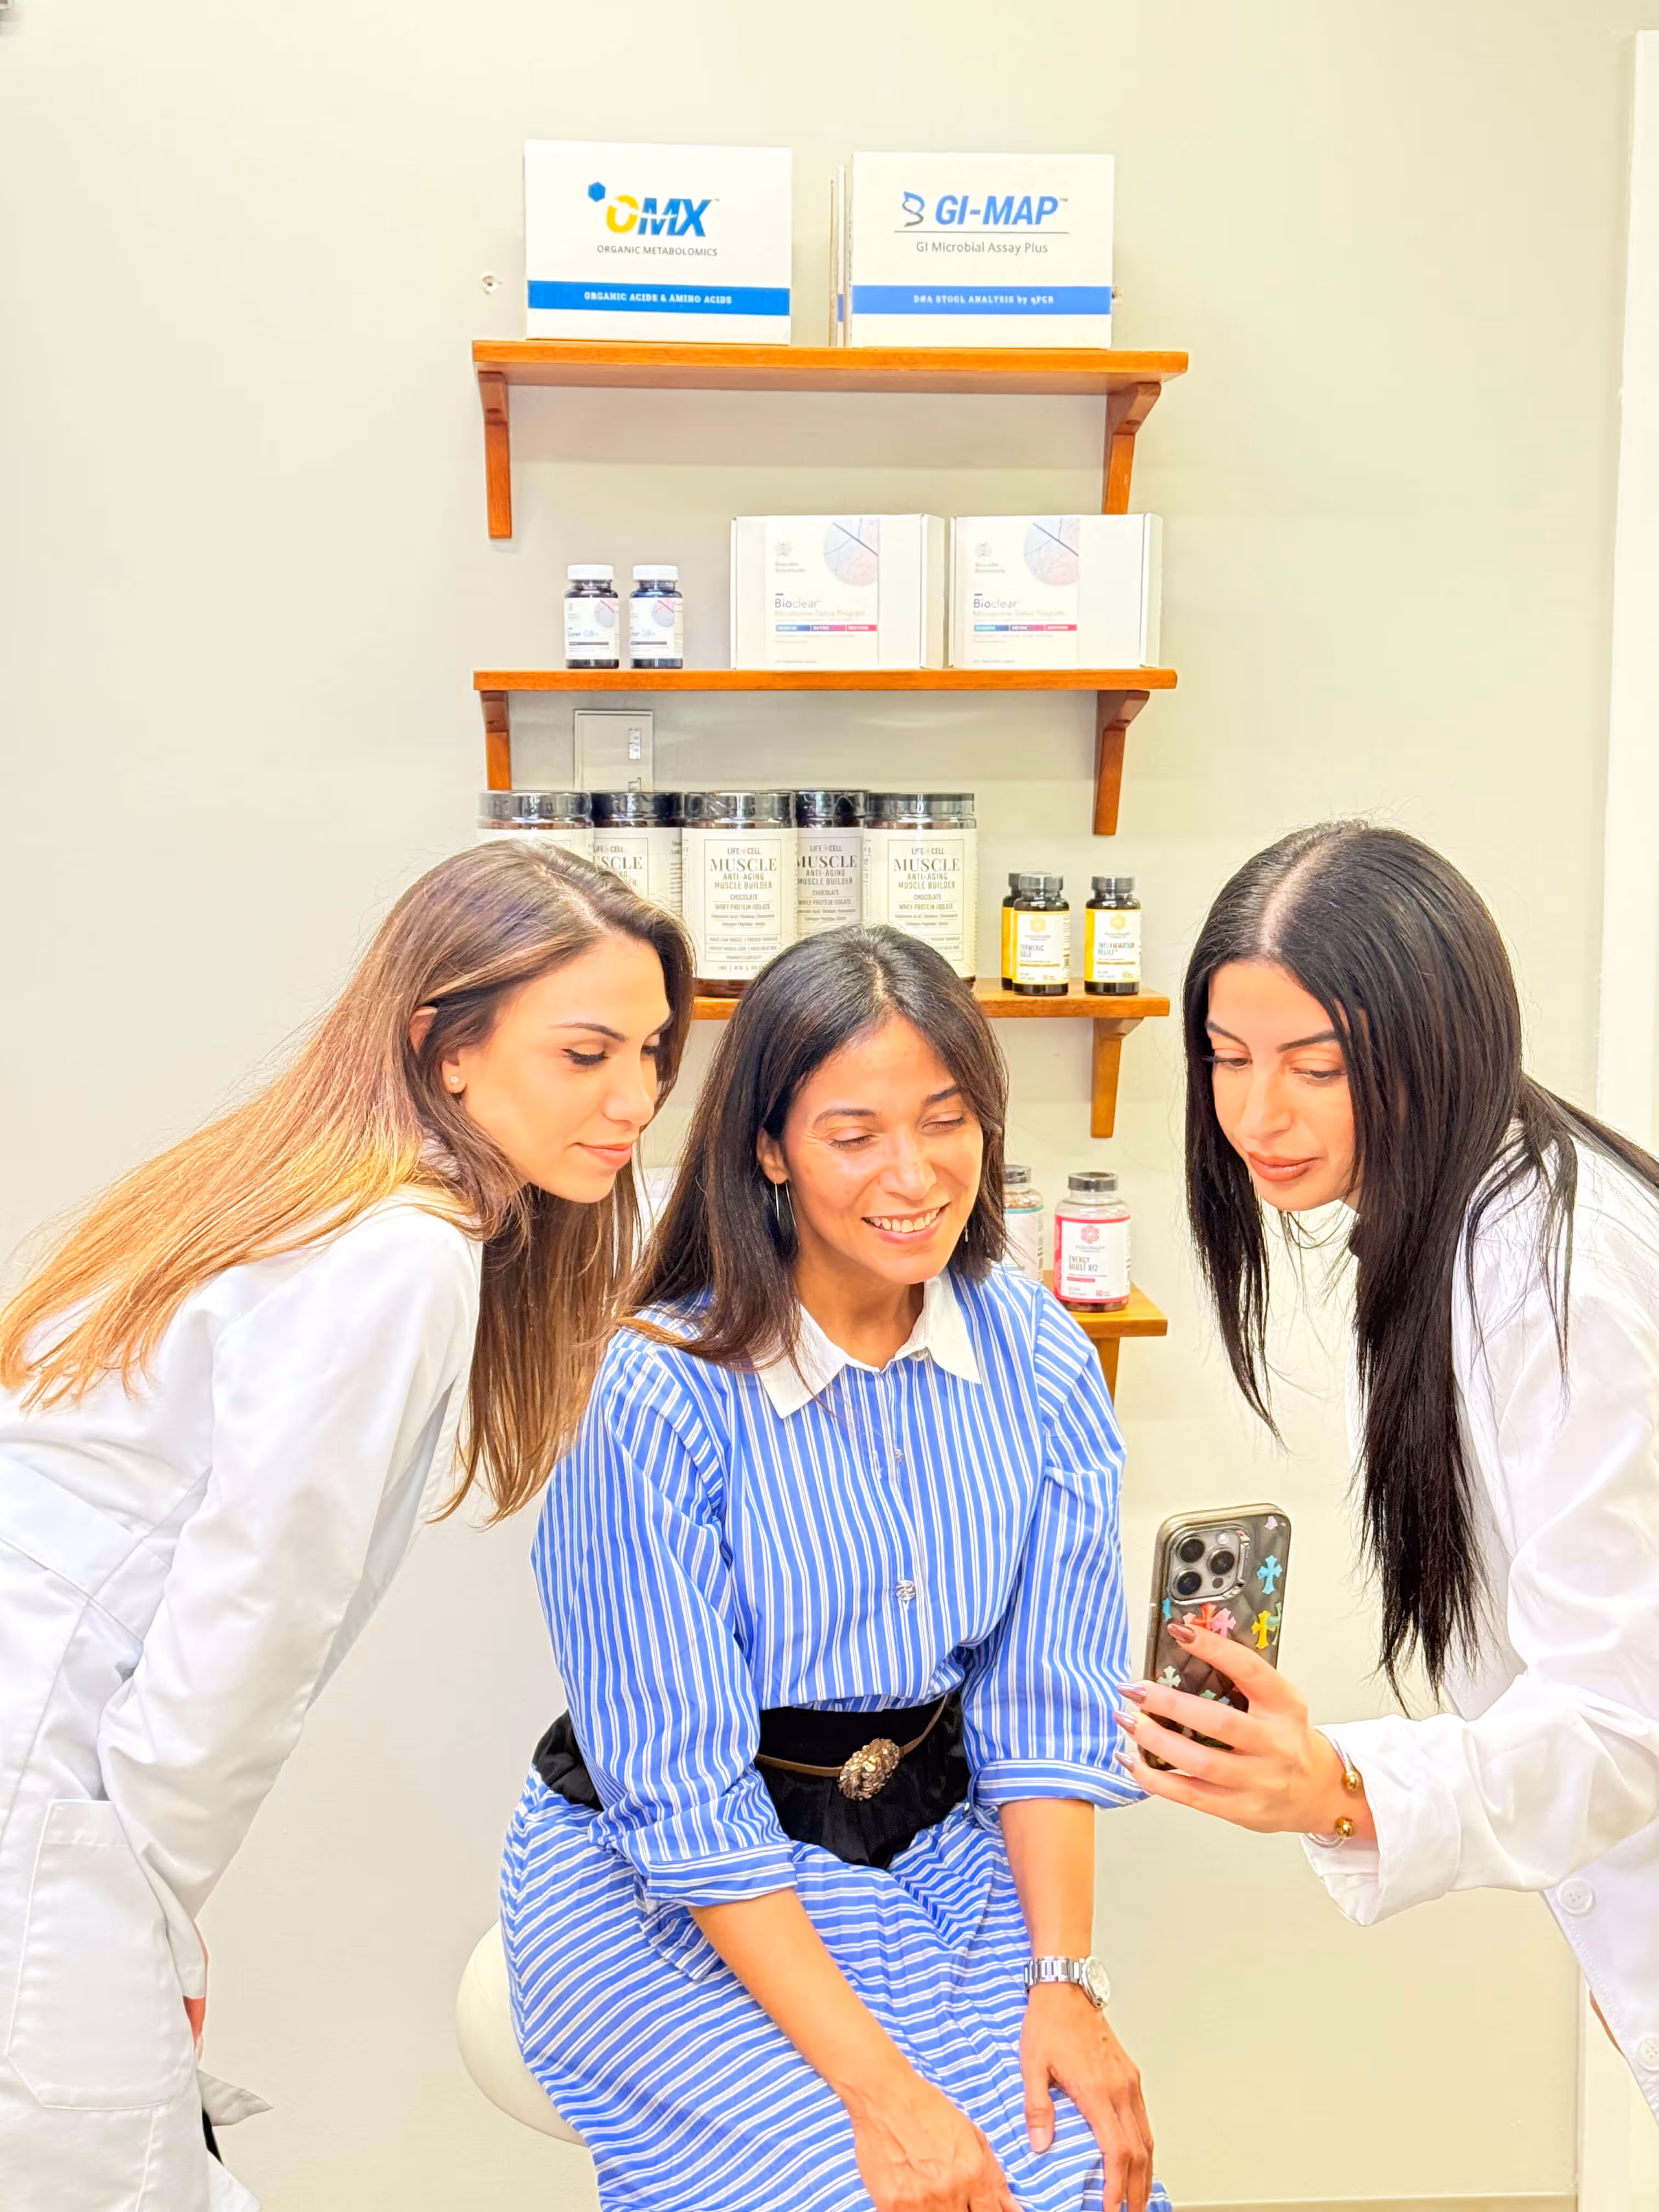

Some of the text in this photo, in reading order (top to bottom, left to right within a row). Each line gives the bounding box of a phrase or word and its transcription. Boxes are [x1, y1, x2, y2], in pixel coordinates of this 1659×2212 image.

[935, 194, 1058, 225] GI-MAP
[606, 195, 712, 237] OMX
[596, 245, 718, 256] ORGANIC METABOLOMICS
[916, 241, 1048, 255] GI Microbial Assay Plus
[584, 291, 732, 304] ORGANIC ACIDS & AMINO ACIDS
[913, 294, 1054, 305] DNA STOOL ANALYSIS by qPCR
[775, 597, 817, 608] Bioclear
[973, 597, 1017, 608] Bioclear
[710, 858, 777, 872] MUSCLE
[797, 855, 857, 868] MUSCLE
[894, 858, 960, 872] MUSCLE
[907, 872, 948, 881] ANTI-AGING
[744, 881, 772, 889] BUILDER
[928, 881, 955, 889] BUILDER
